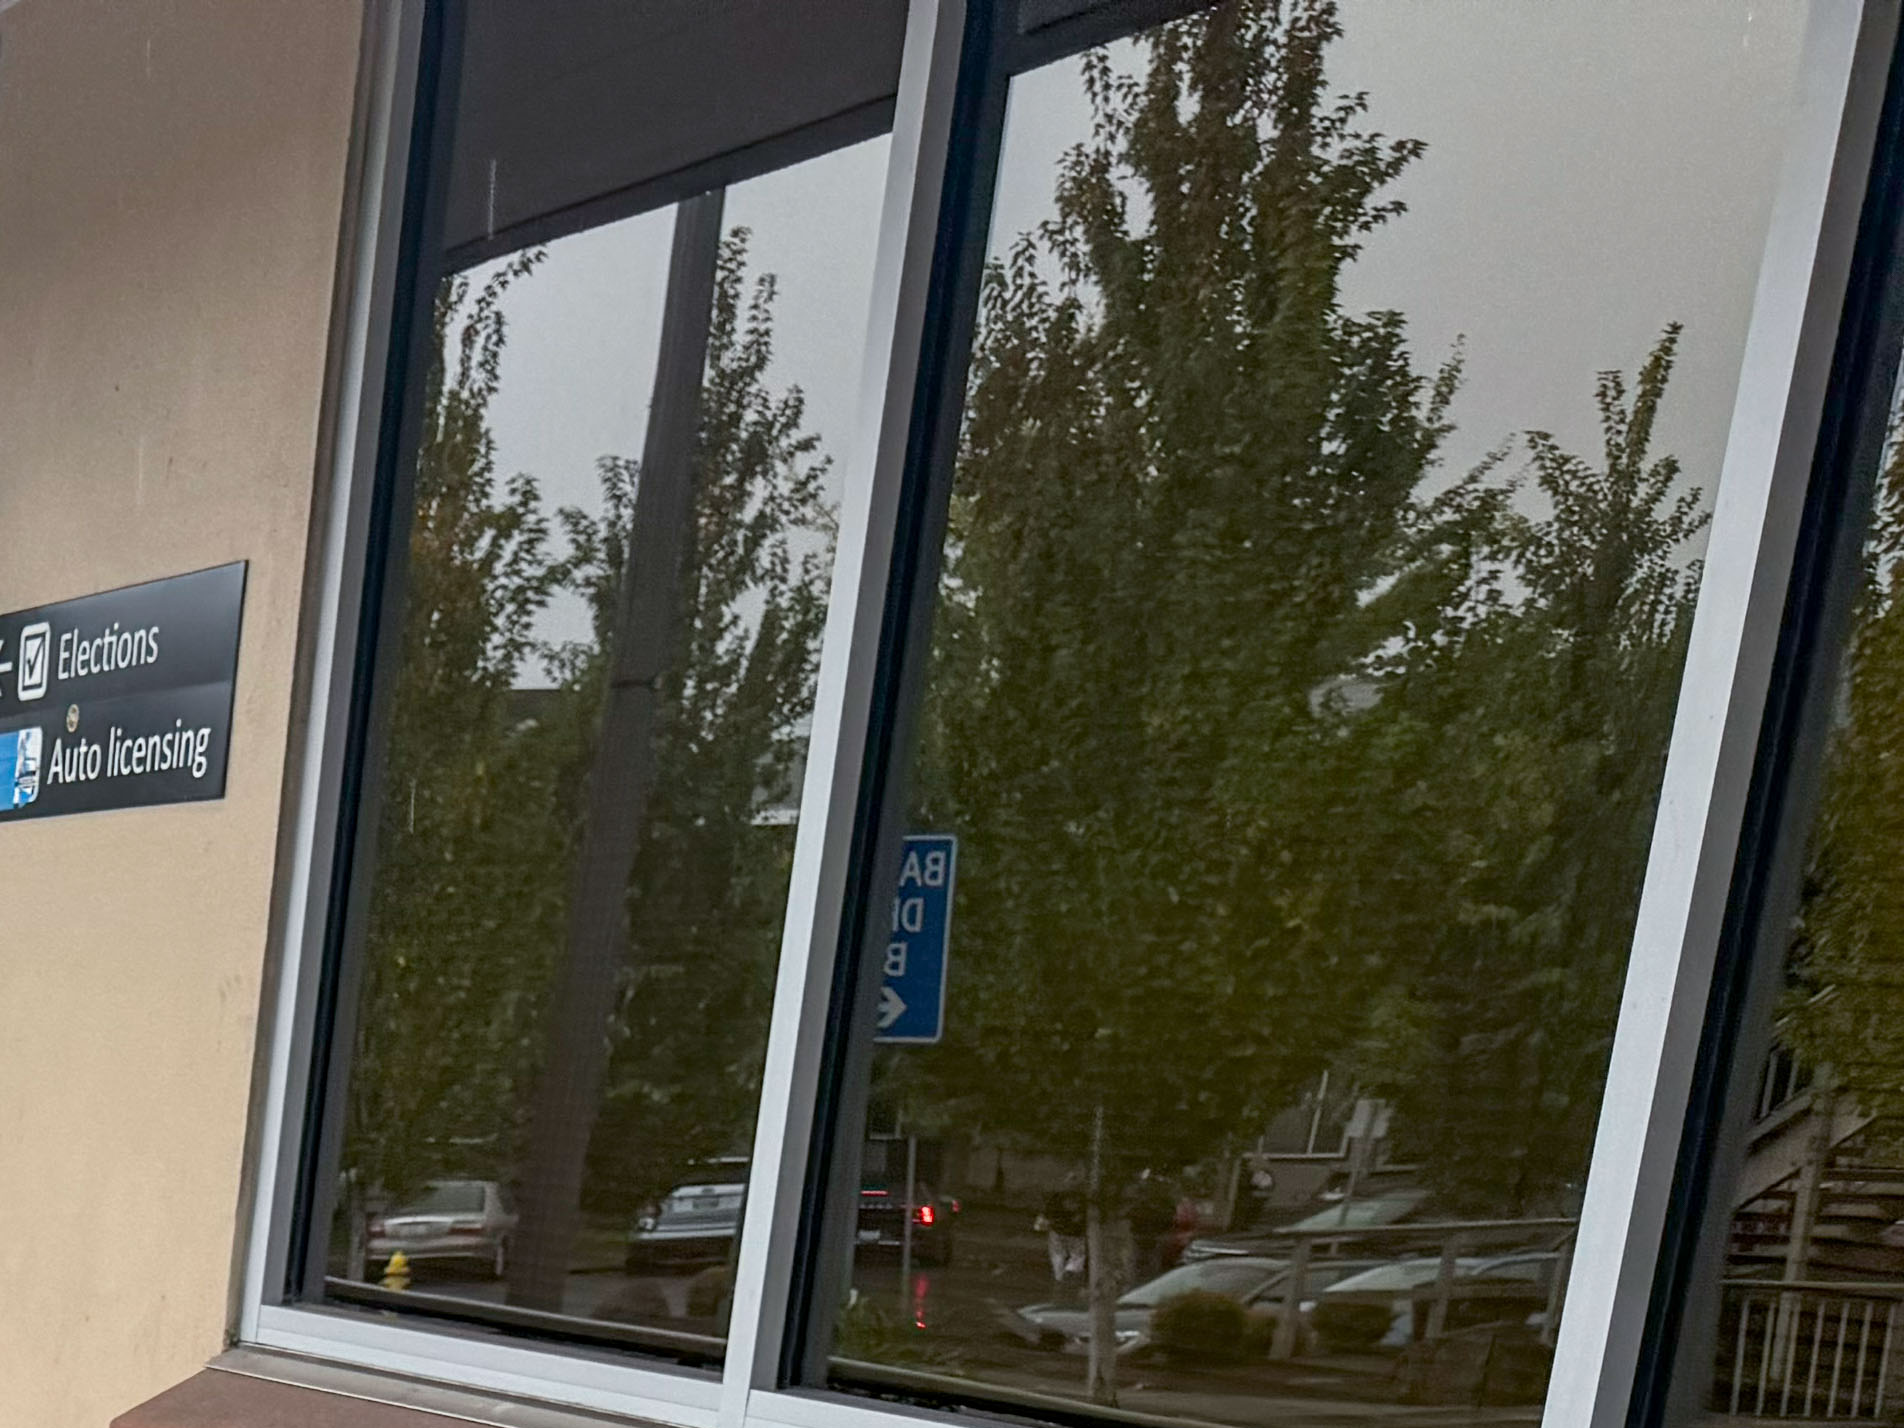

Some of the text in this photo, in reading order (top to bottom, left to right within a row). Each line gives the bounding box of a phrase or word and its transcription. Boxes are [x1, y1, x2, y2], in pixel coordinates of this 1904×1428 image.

[57, 622, 159, 680] Elections
[47, 718, 212, 785] Auto licensing
